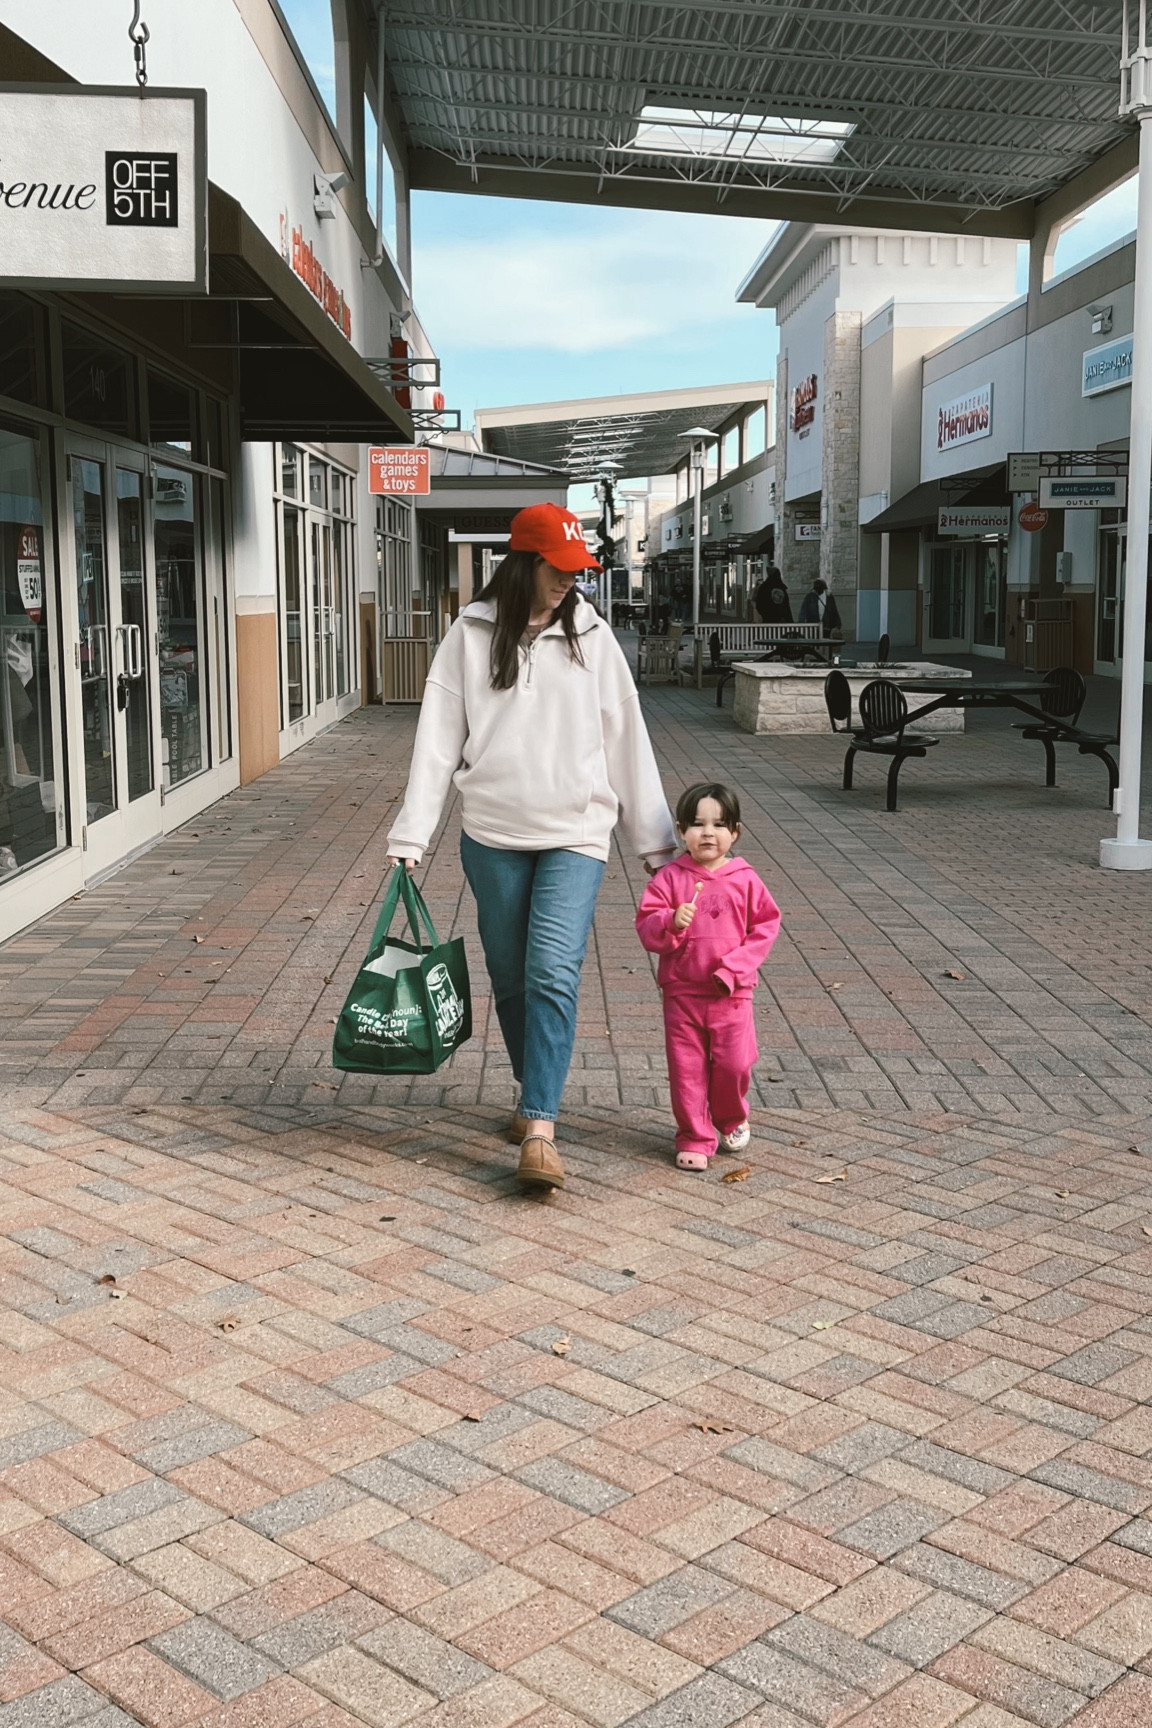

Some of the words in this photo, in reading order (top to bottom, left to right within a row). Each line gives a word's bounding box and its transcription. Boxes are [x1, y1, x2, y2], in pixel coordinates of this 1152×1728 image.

[112, 159, 170, 189] OFF
[113, 189, 171, 219] 5TH
[1085, 361, 1106, 381] JANIE
[1112, 351, 1133, 371] JACK
[943, 404, 989, 443] Hermanos
[371, 450, 427, 465] calendars
[380, 465, 418, 479] games
[1054, 485, 1079, 493] JANIE
[1090, 485, 1113, 493] JACK
[461, 515, 511, 528] GUESS
[949, 515, 1009, 526] Hermanos
[22, 535, 39, 557] SALE
[350, 1003, 381, 1019] Candle
[392, 1004, 422, 1018] noun]:
[357, 1014, 374, 1025] The
[390, 1018, 409, 1029] Day
[358, 1025, 368, 1034] of
[368, 1026, 382, 1037] the
